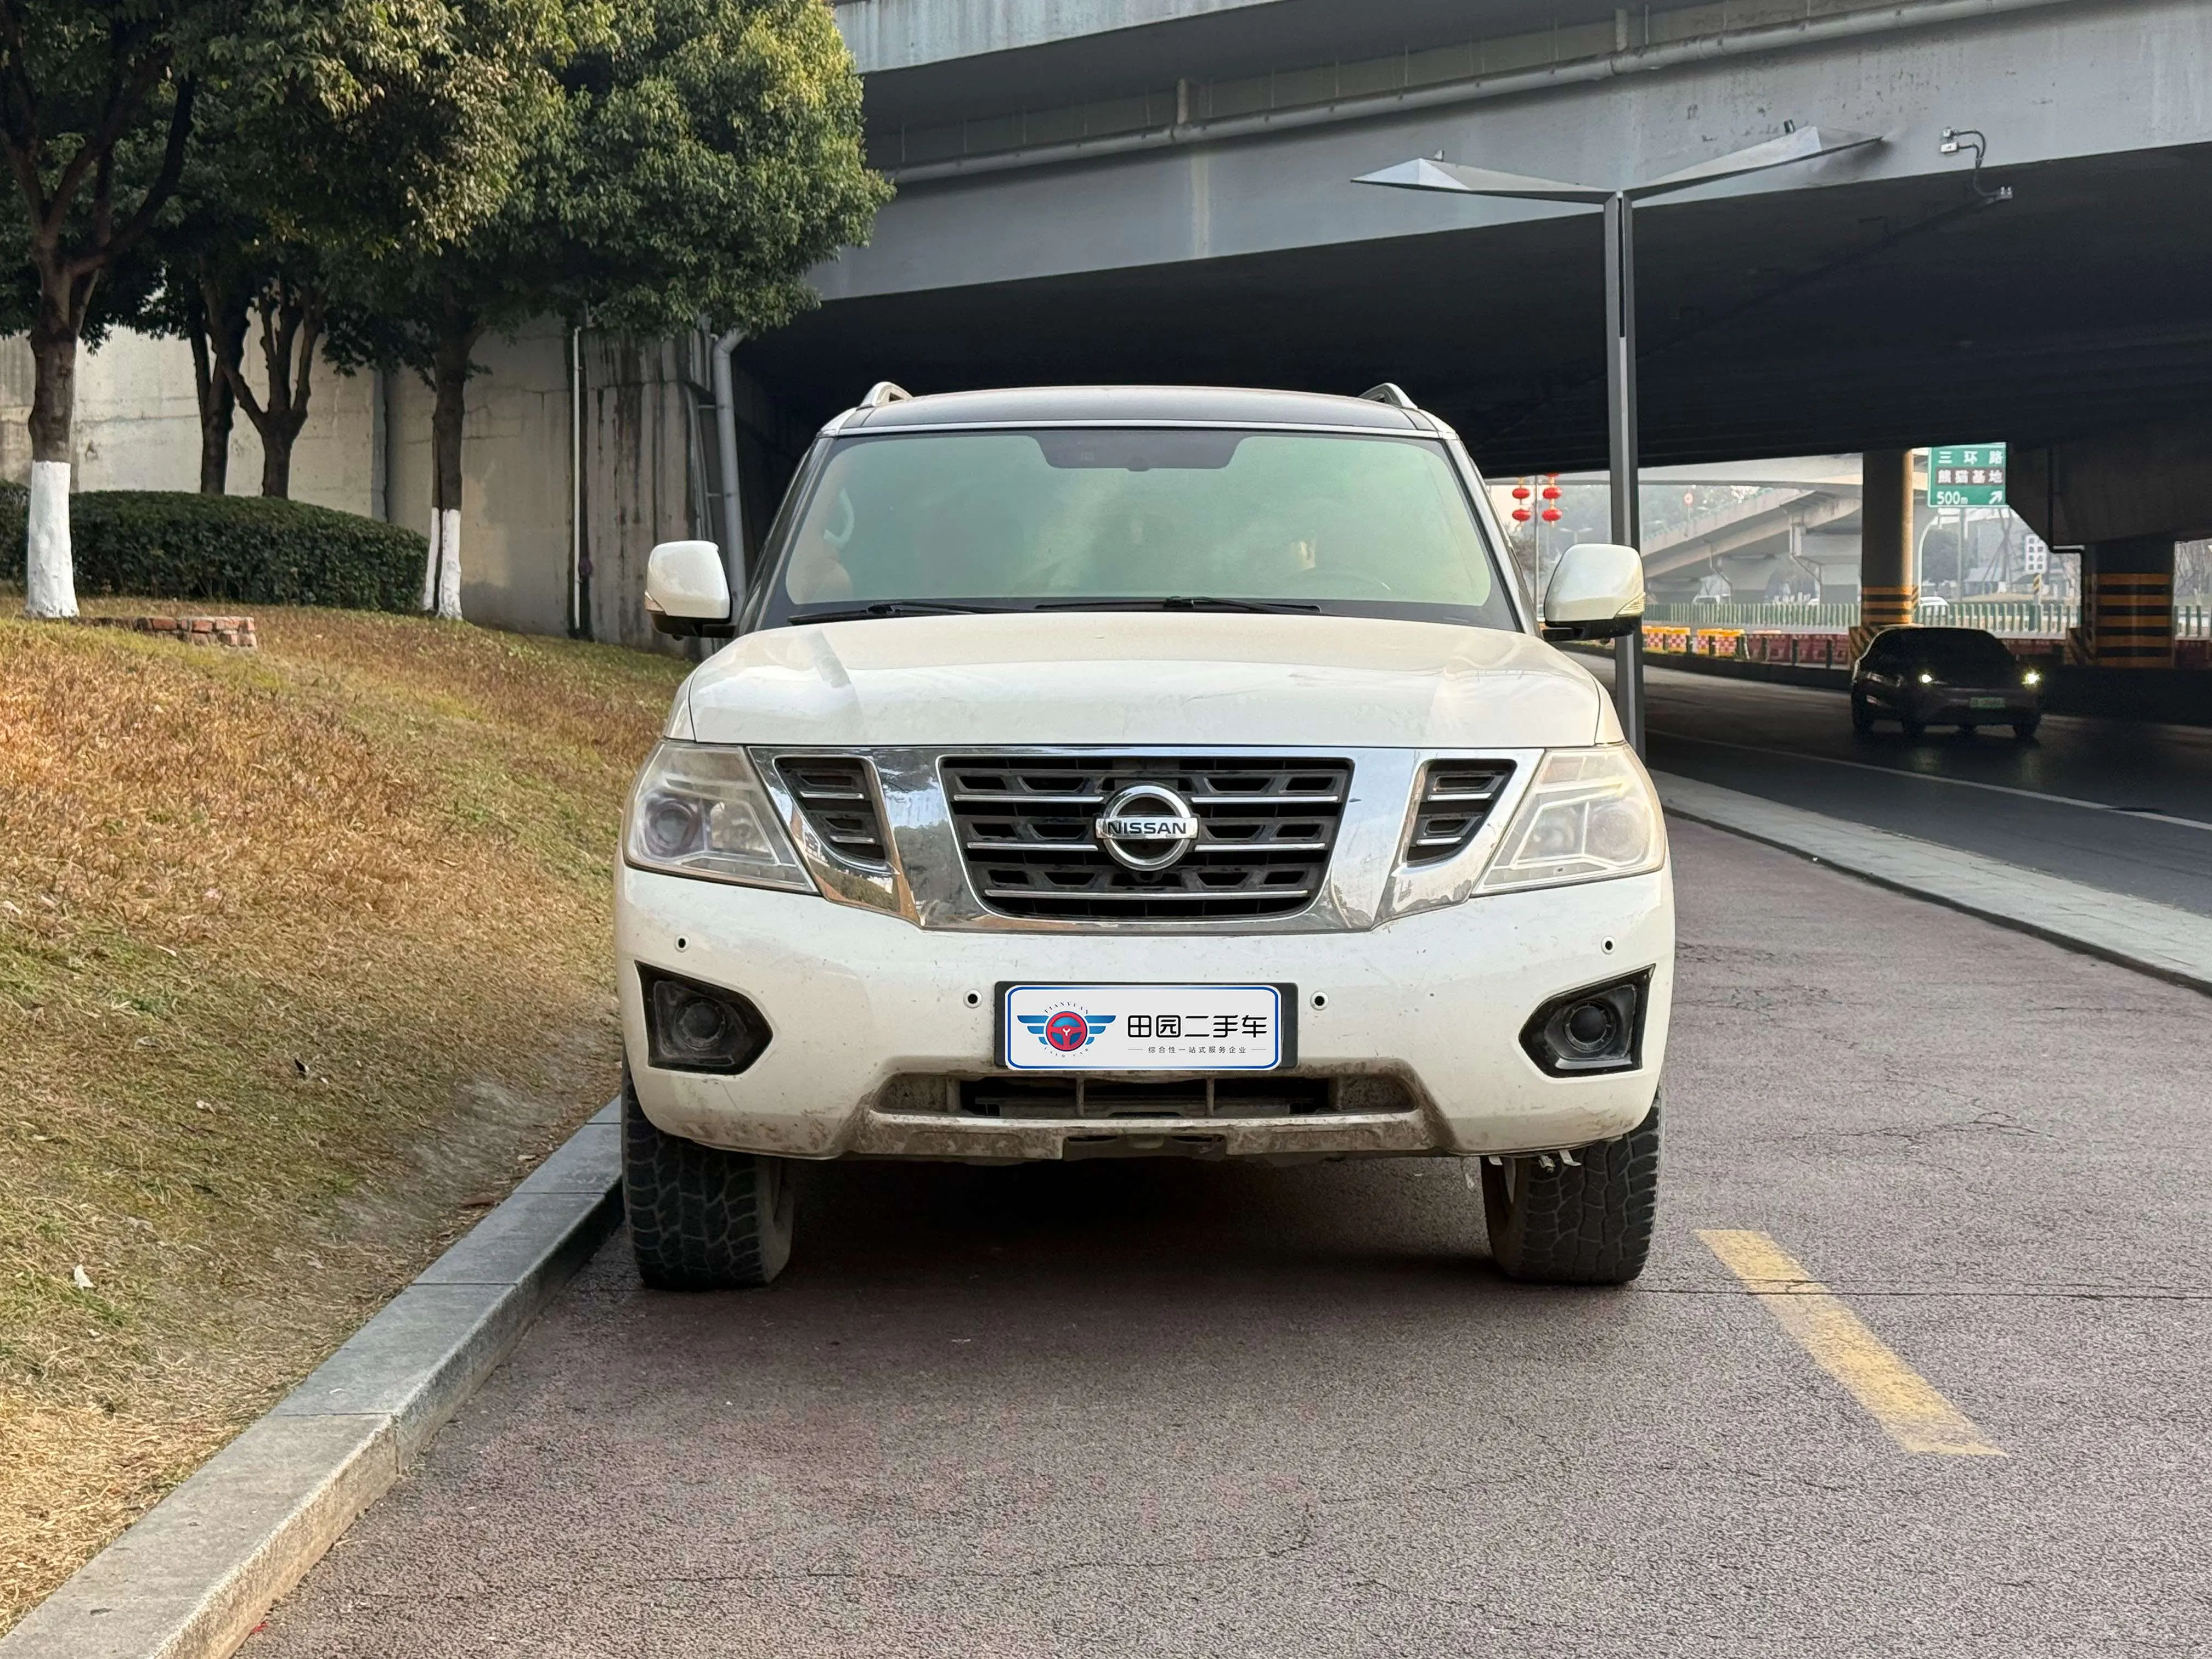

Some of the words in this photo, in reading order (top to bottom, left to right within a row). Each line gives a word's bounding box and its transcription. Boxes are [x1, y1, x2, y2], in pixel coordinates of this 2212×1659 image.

[1938, 450, 2004, 465] 三环路
[1938, 469, 2003, 484] 熊猫基地
[1937, 490, 1968, 505] 500m
[1107, 820, 1187, 834] NISSAN
